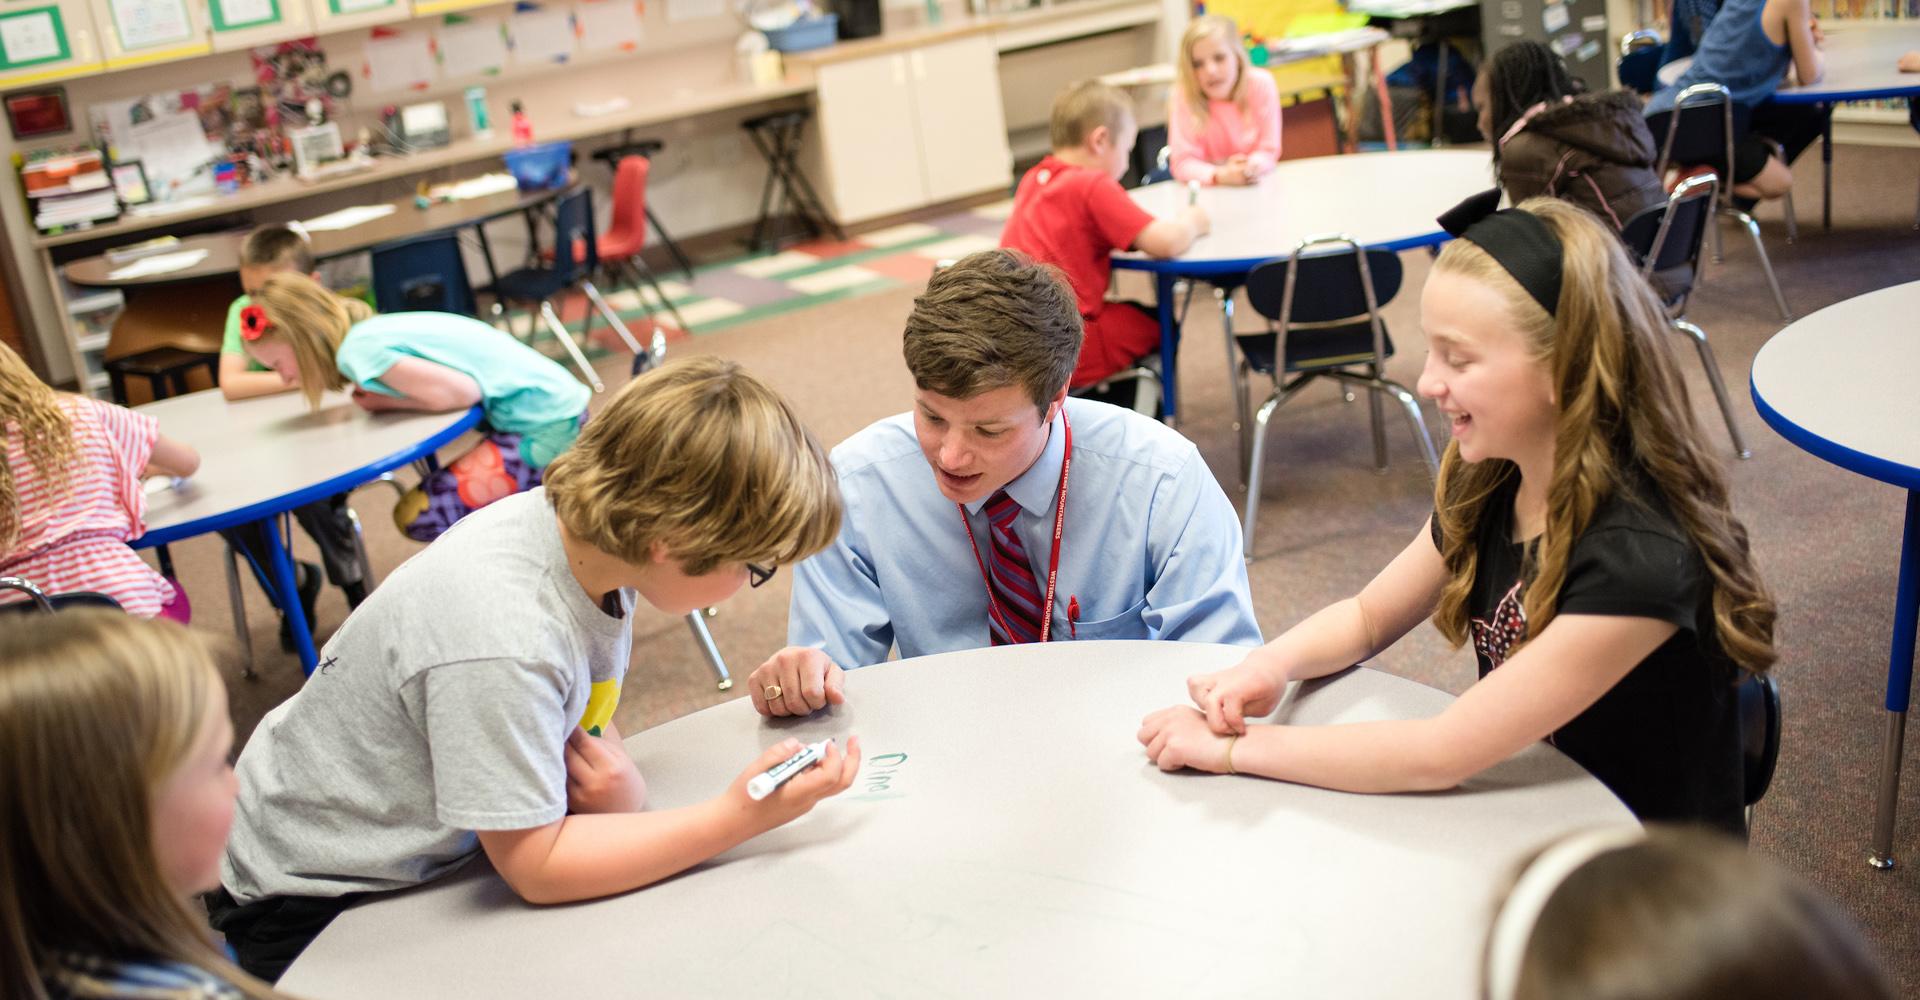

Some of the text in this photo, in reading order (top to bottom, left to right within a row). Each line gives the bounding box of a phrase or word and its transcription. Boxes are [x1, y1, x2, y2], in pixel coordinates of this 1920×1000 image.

[1055, 459, 1070, 539] WESTERN MOUNTAINEERS
[1048, 570, 1057, 599] WESTERN
